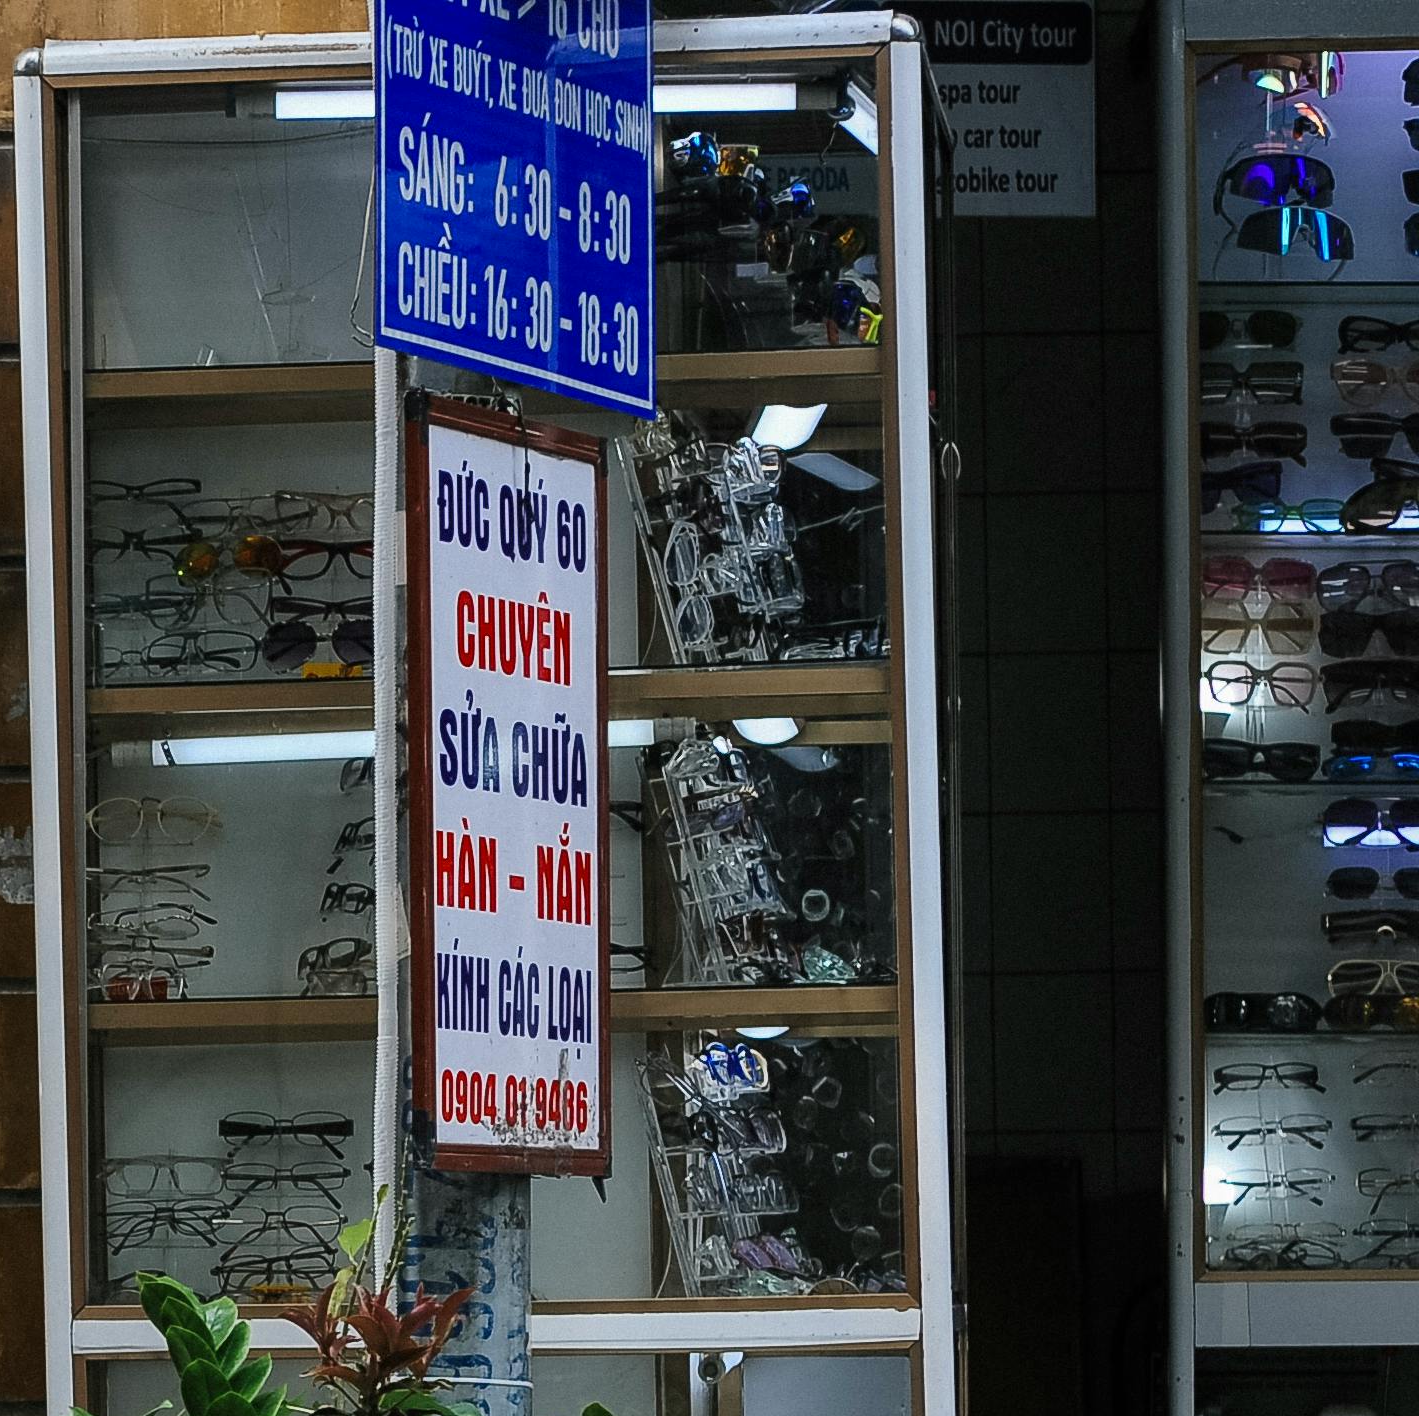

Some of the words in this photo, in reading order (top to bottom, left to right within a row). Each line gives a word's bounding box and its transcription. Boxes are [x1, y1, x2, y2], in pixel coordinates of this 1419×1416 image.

[935, 20, 975, 46] NOI
[983, 19, 1024, 54] City
[1031, 23, 1076, 47] tour
[429, 34, 449, 88] XE
[499, 58, 517, 111] XE
[585, 89, 612, 148] HỌC
[938, 83, 972, 109] spa
[978, 80, 1021, 104] tour
[964, 127, 994, 148] car
[1000, 125, 1042, 148] tour
[399, 112, 475, 215] SÁNG:
[953, 166, 1011, 193] obike
[1015, 169, 1059, 193] tour
[398, 221, 478, 330] CHIỀU:
[437, 460, 490, 552] ĐỨC
[557, 499, 587, 573] 60
[456, 591, 571, 686] CHUYÊN
[439, 689, 501, 793] SỬA
[512, 713, 587, 807] CHỮA
[436, 817, 497, 913] HÀN
[536, 822, 592, 926] NẮN
[437, 938, 490, 1034] KÍNH
[498, 946, 541, 1040] CÁC
[547, 964, 592, 1060] LOẠI
[441, 1067, 498, 1126] 0904
